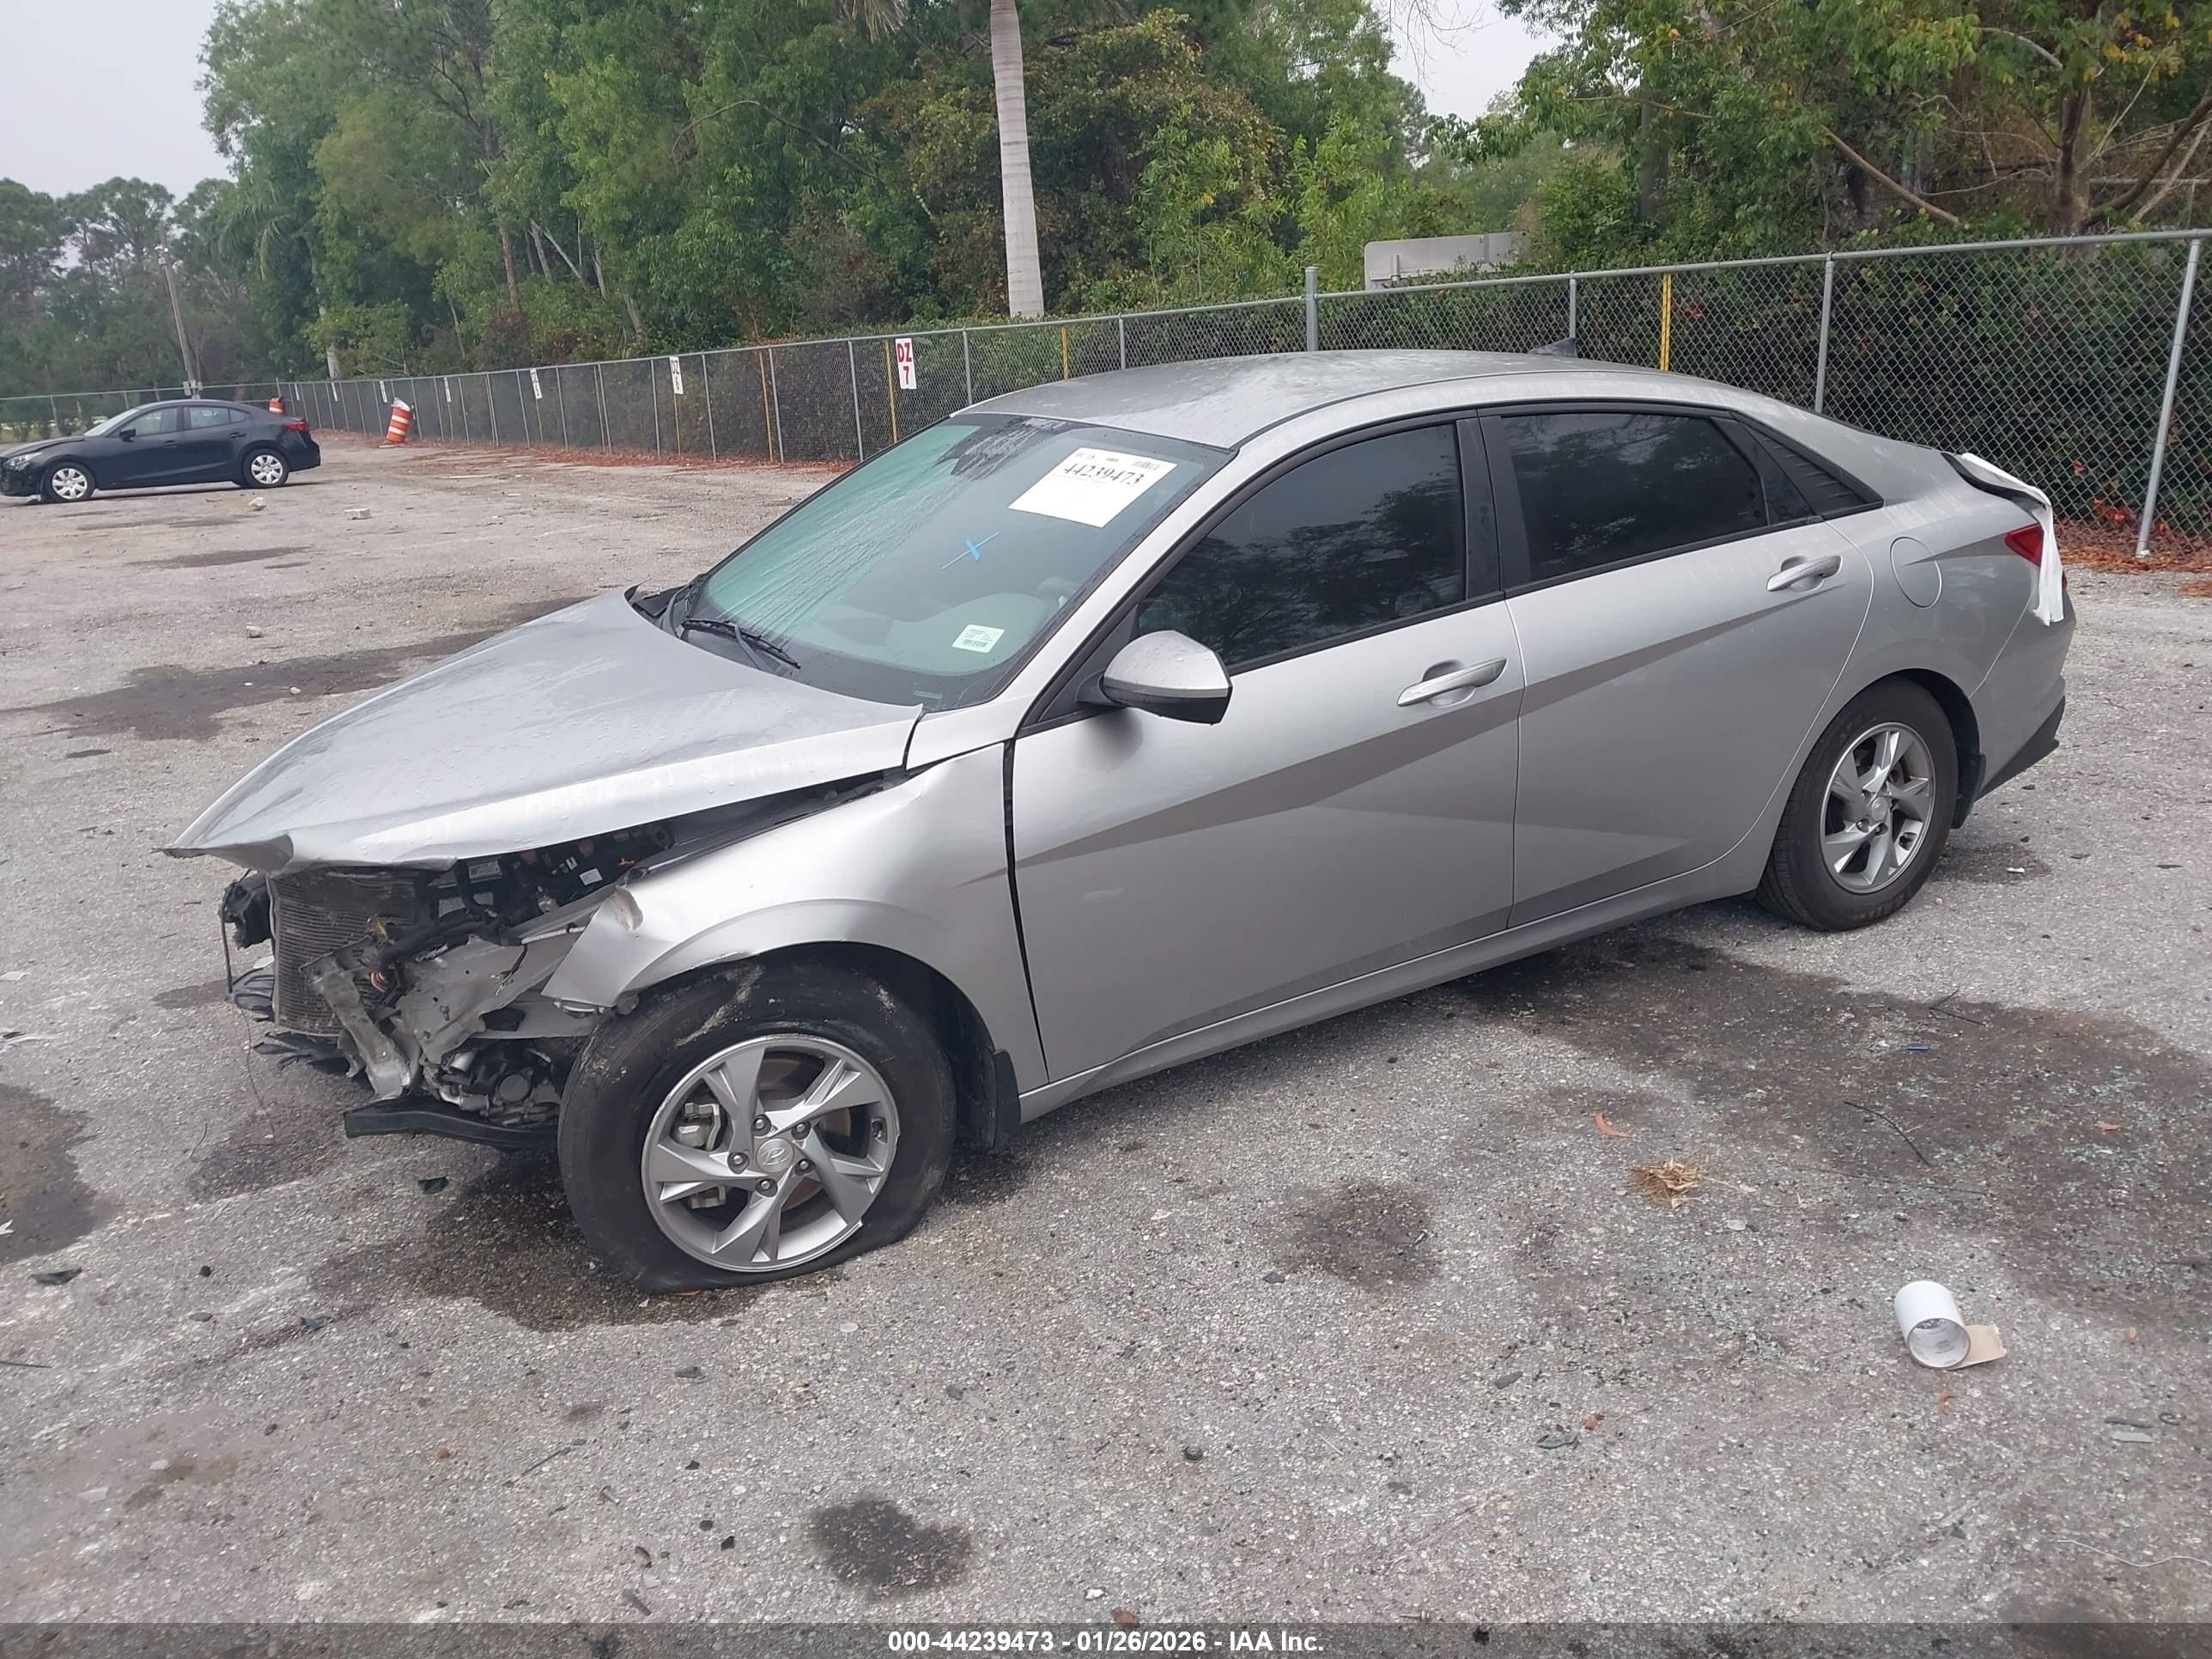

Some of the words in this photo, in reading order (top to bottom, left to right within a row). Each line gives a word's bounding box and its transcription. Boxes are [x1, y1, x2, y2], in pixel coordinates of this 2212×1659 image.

[896, 342, 913, 362] DZ
[902, 366, 909, 386] 7
[1064, 463, 1145, 485] 44239473
